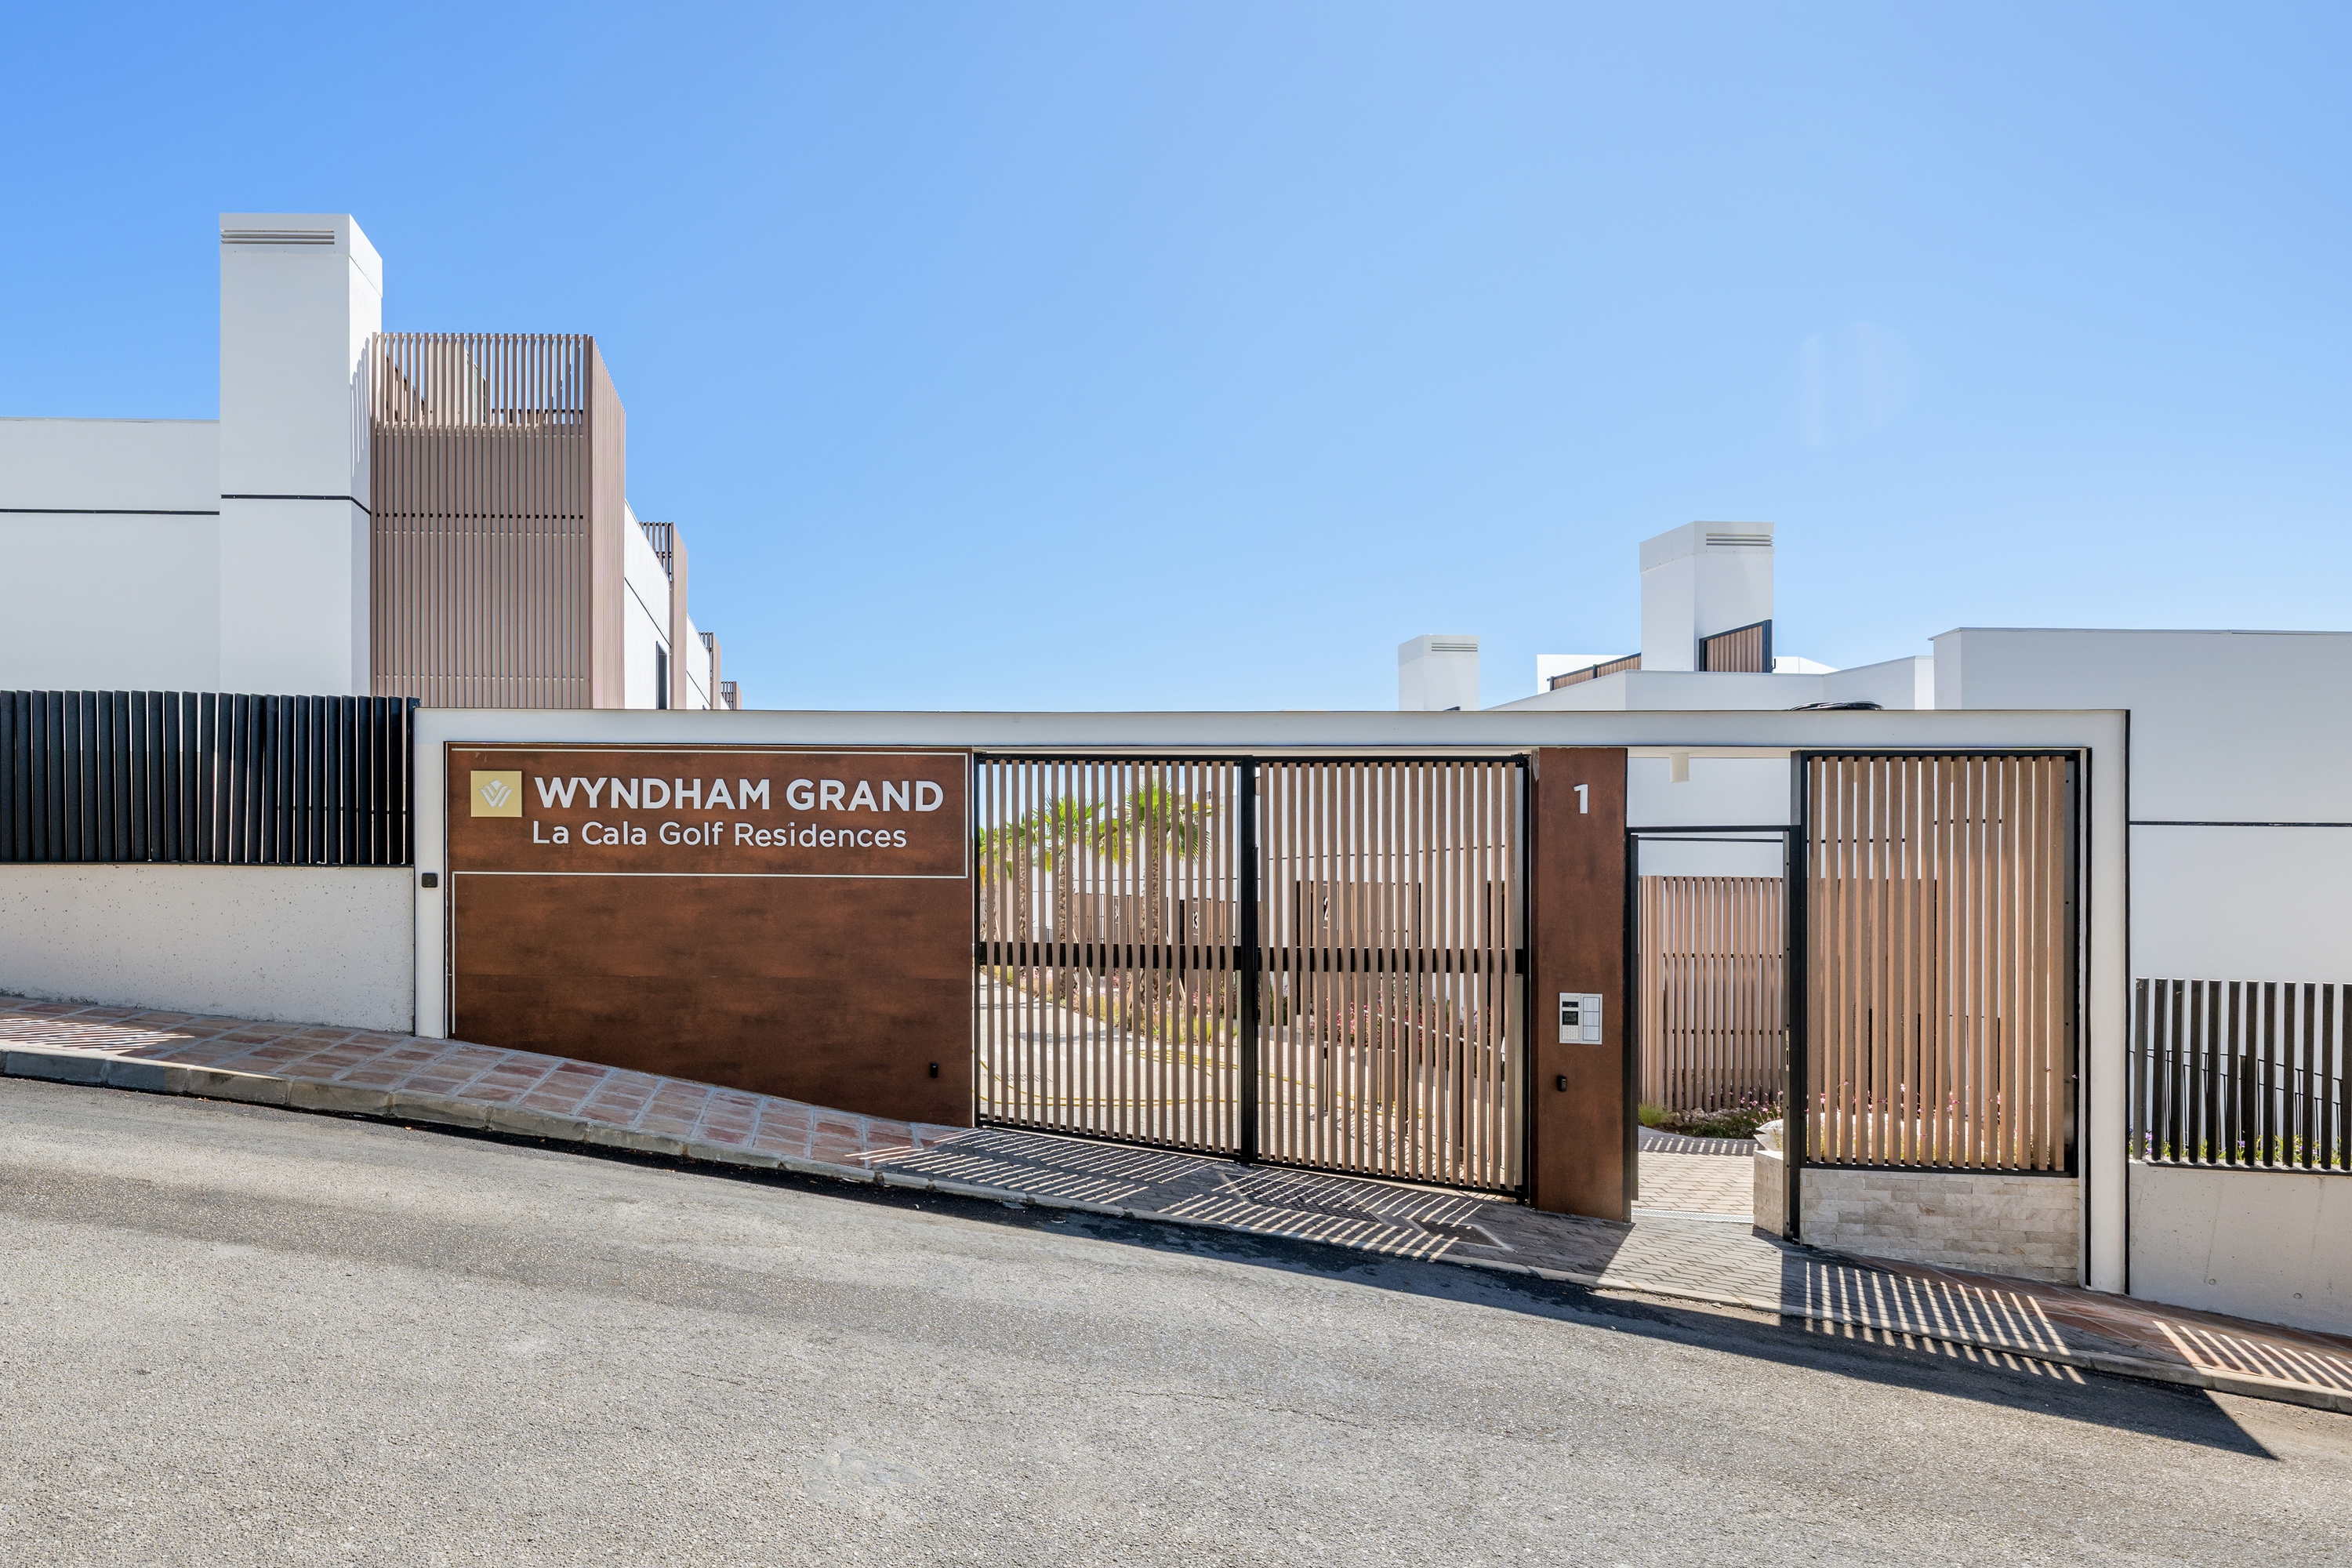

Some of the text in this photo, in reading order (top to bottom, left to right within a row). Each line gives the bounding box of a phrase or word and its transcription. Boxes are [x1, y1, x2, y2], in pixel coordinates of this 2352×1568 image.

[534, 777, 944, 811] WYNDHAM GRAND
[1573, 784, 1588, 814] 1
[533, 820, 907, 848] La Cala Golf Residences
